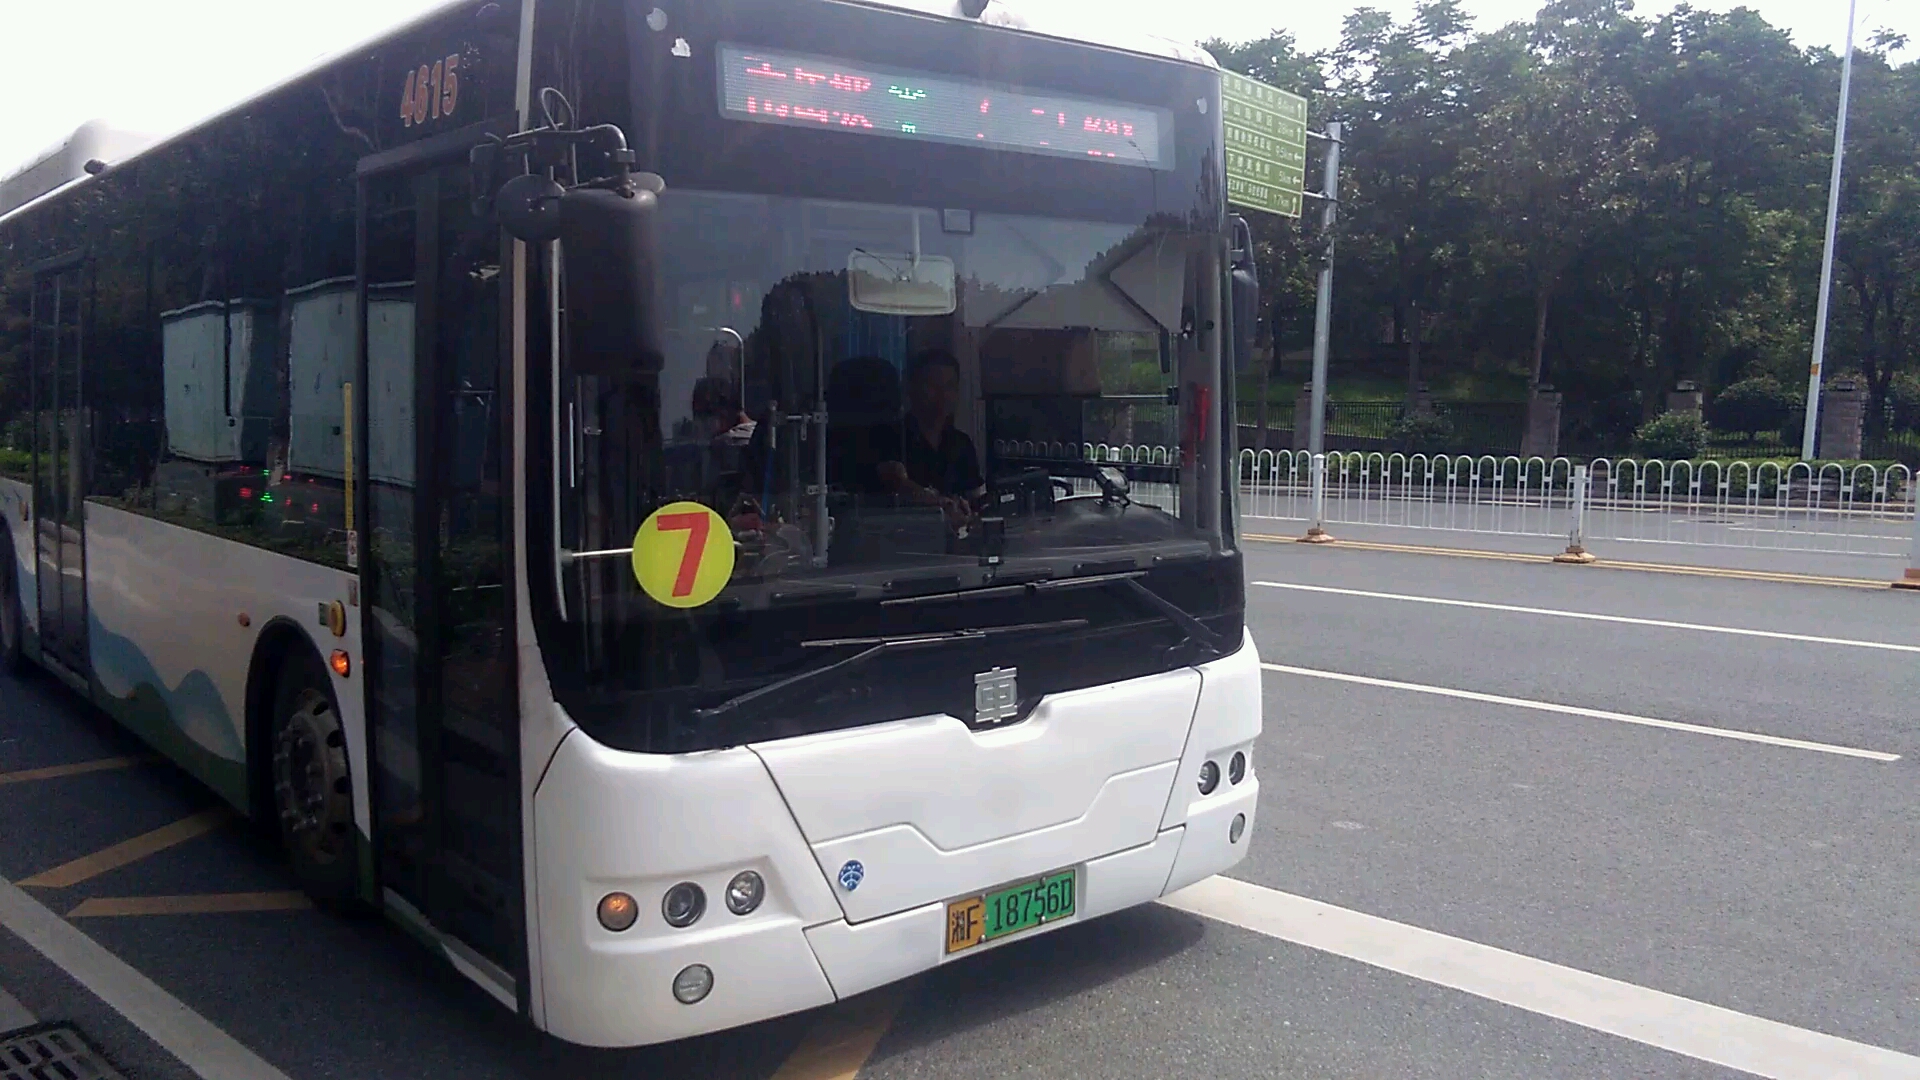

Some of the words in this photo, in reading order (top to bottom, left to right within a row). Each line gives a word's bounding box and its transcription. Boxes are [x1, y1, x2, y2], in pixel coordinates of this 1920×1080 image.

[401, 54, 459, 127] 4615
[657, 511, 710, 597] 7
[993, 877, 1072, 931] 18756D
